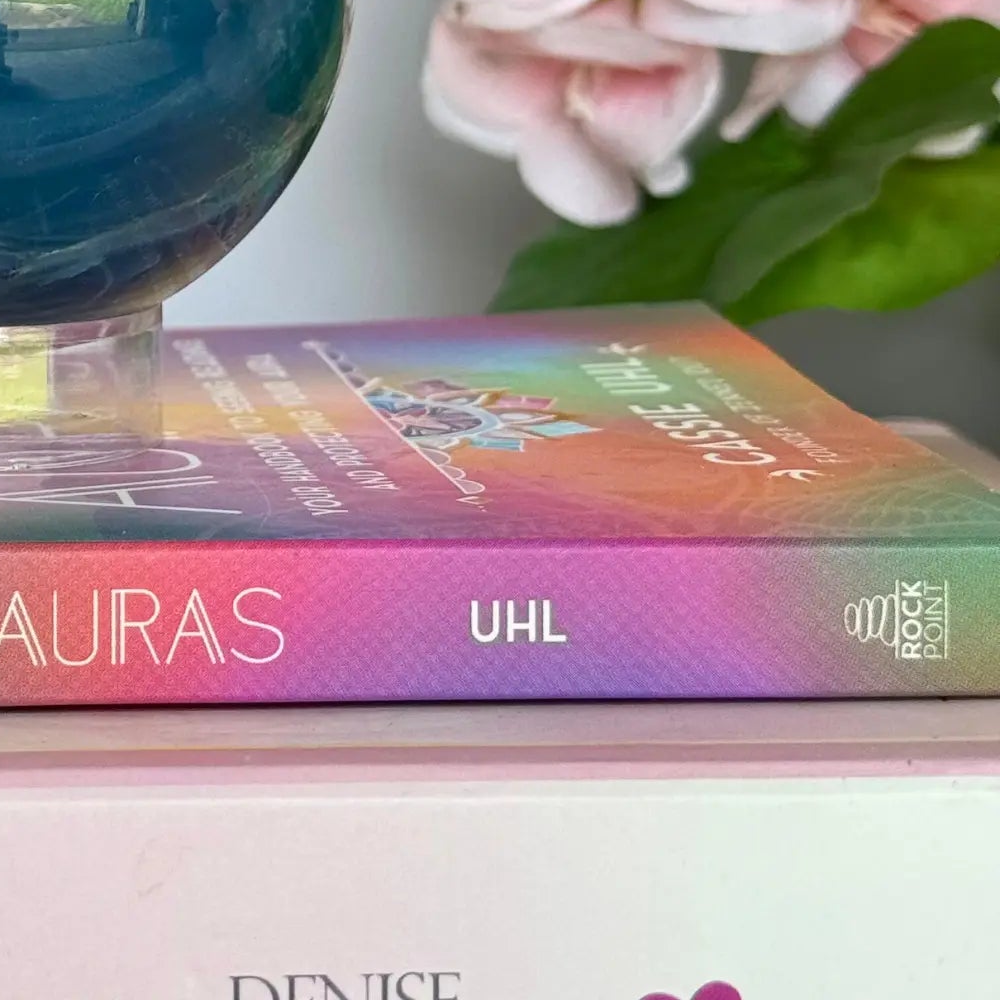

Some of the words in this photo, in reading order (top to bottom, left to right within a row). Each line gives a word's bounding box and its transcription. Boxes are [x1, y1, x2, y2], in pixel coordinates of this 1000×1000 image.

[581, 356, 673, 395] UHL
[288, 410, 374, 467] PROTECTING
[628, 402, 777, 466] CASSIE
[766, 425, 850, 464] FOUNDER
[247, 433, 321, 483] HANDBOOK
[346, 469, 400, 491] AND
[290, 486, 349, 516] YOUR
[469, 599, 568, 643] UHL
[901, 580, 923, 659] ROCK
[924, 580, 943, 659] POINT
